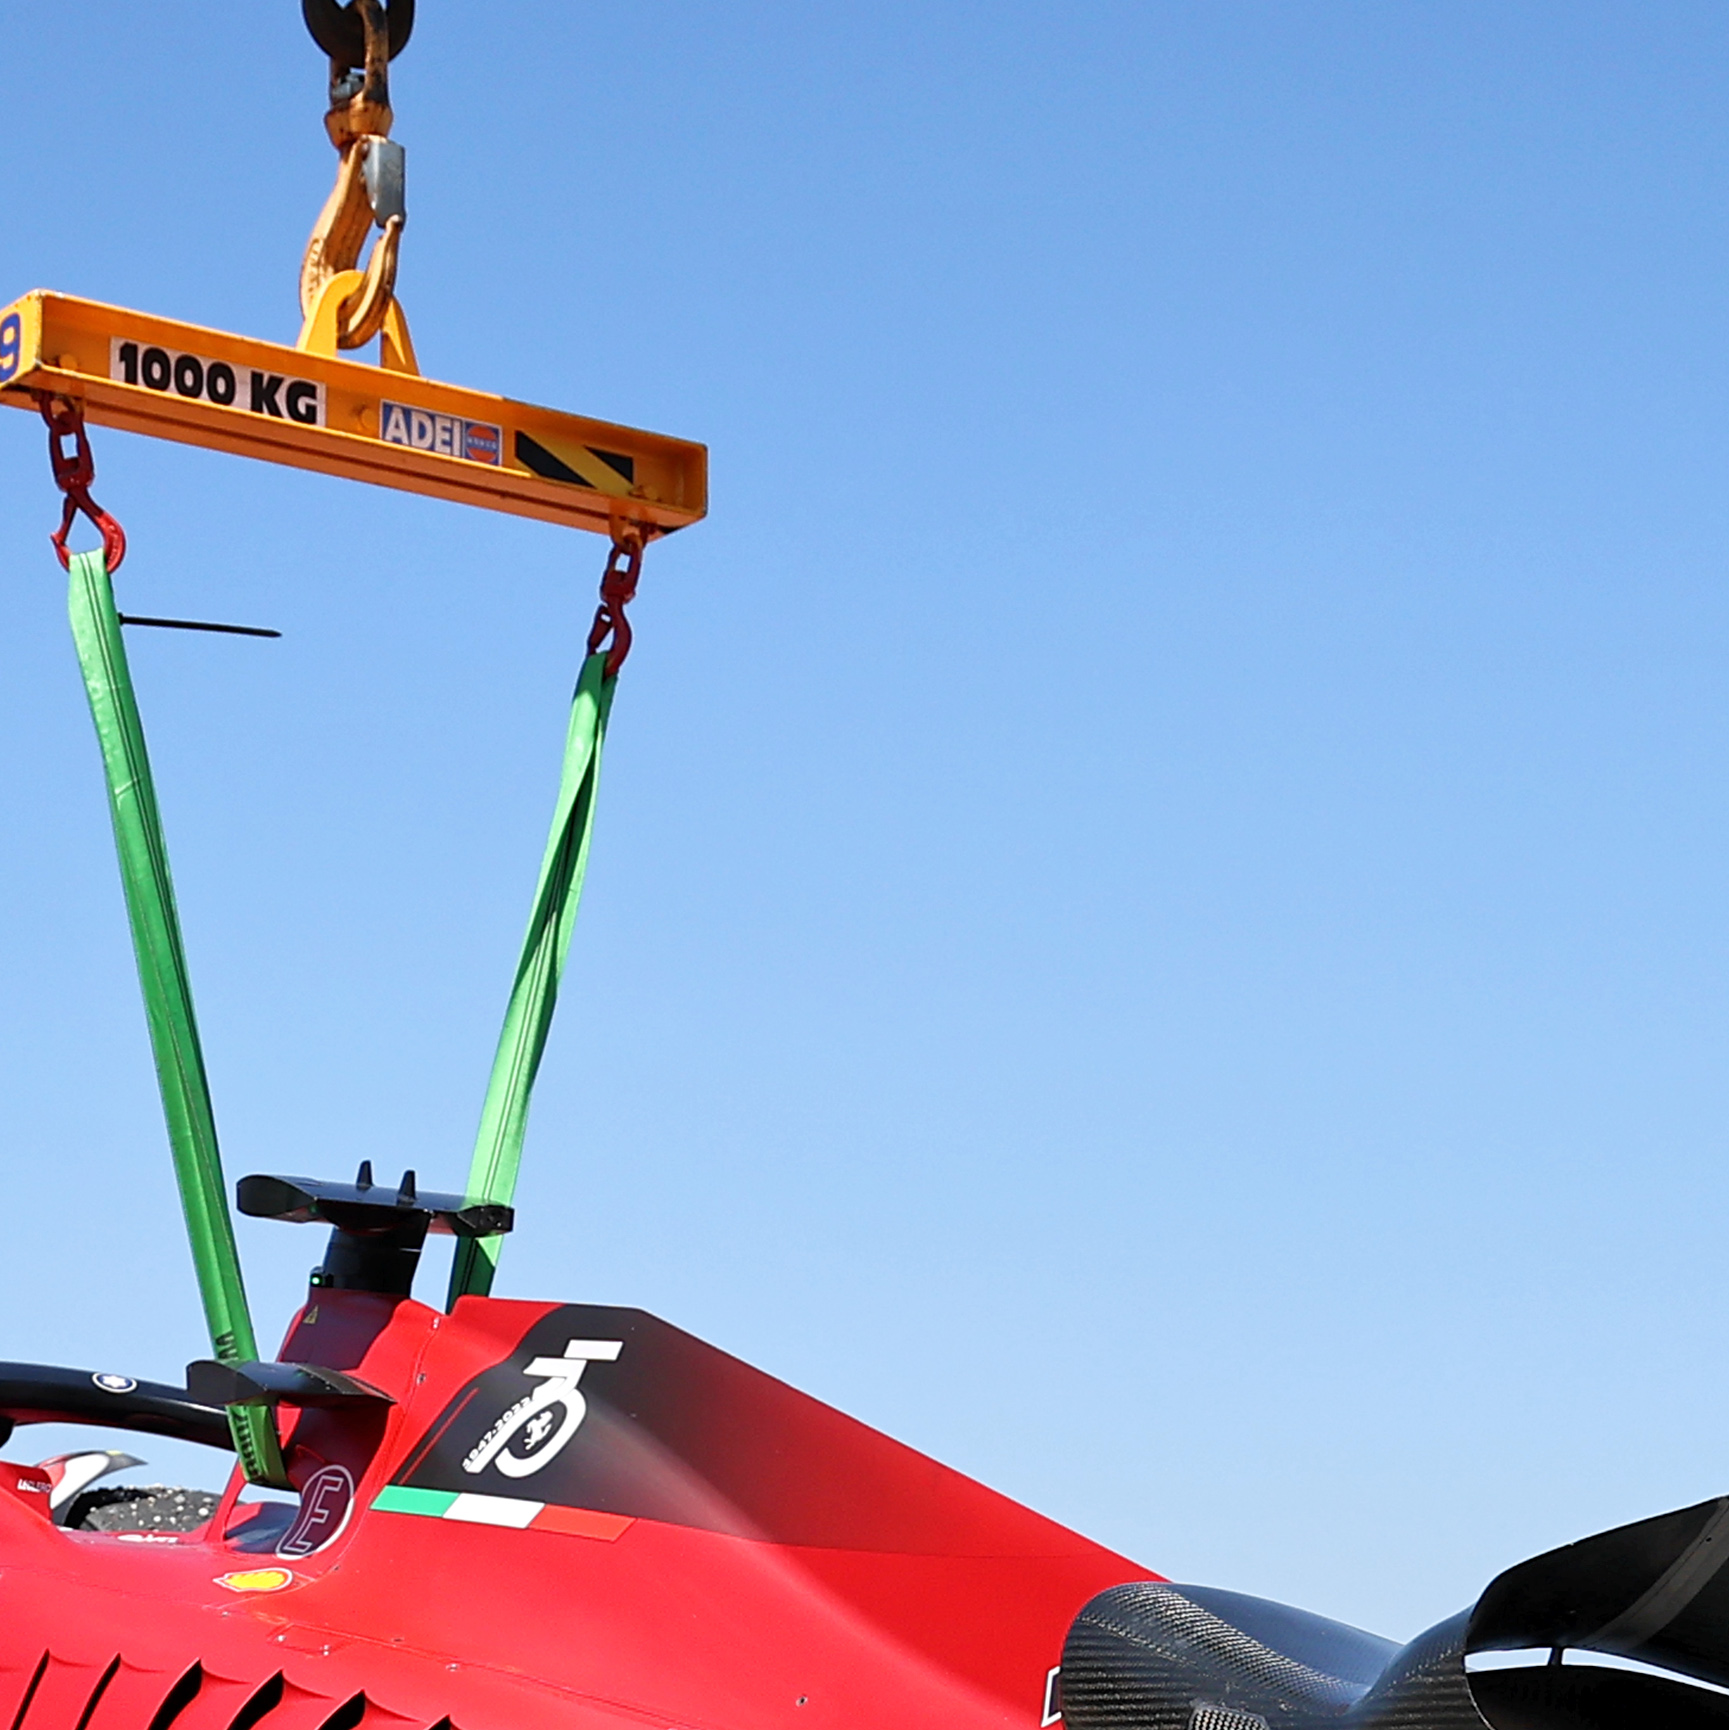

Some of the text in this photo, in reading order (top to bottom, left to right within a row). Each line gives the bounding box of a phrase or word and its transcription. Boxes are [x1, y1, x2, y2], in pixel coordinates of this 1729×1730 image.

[118, 342, 319, 426] 1000 KG
[384, 405, 461, 457] ADEI
